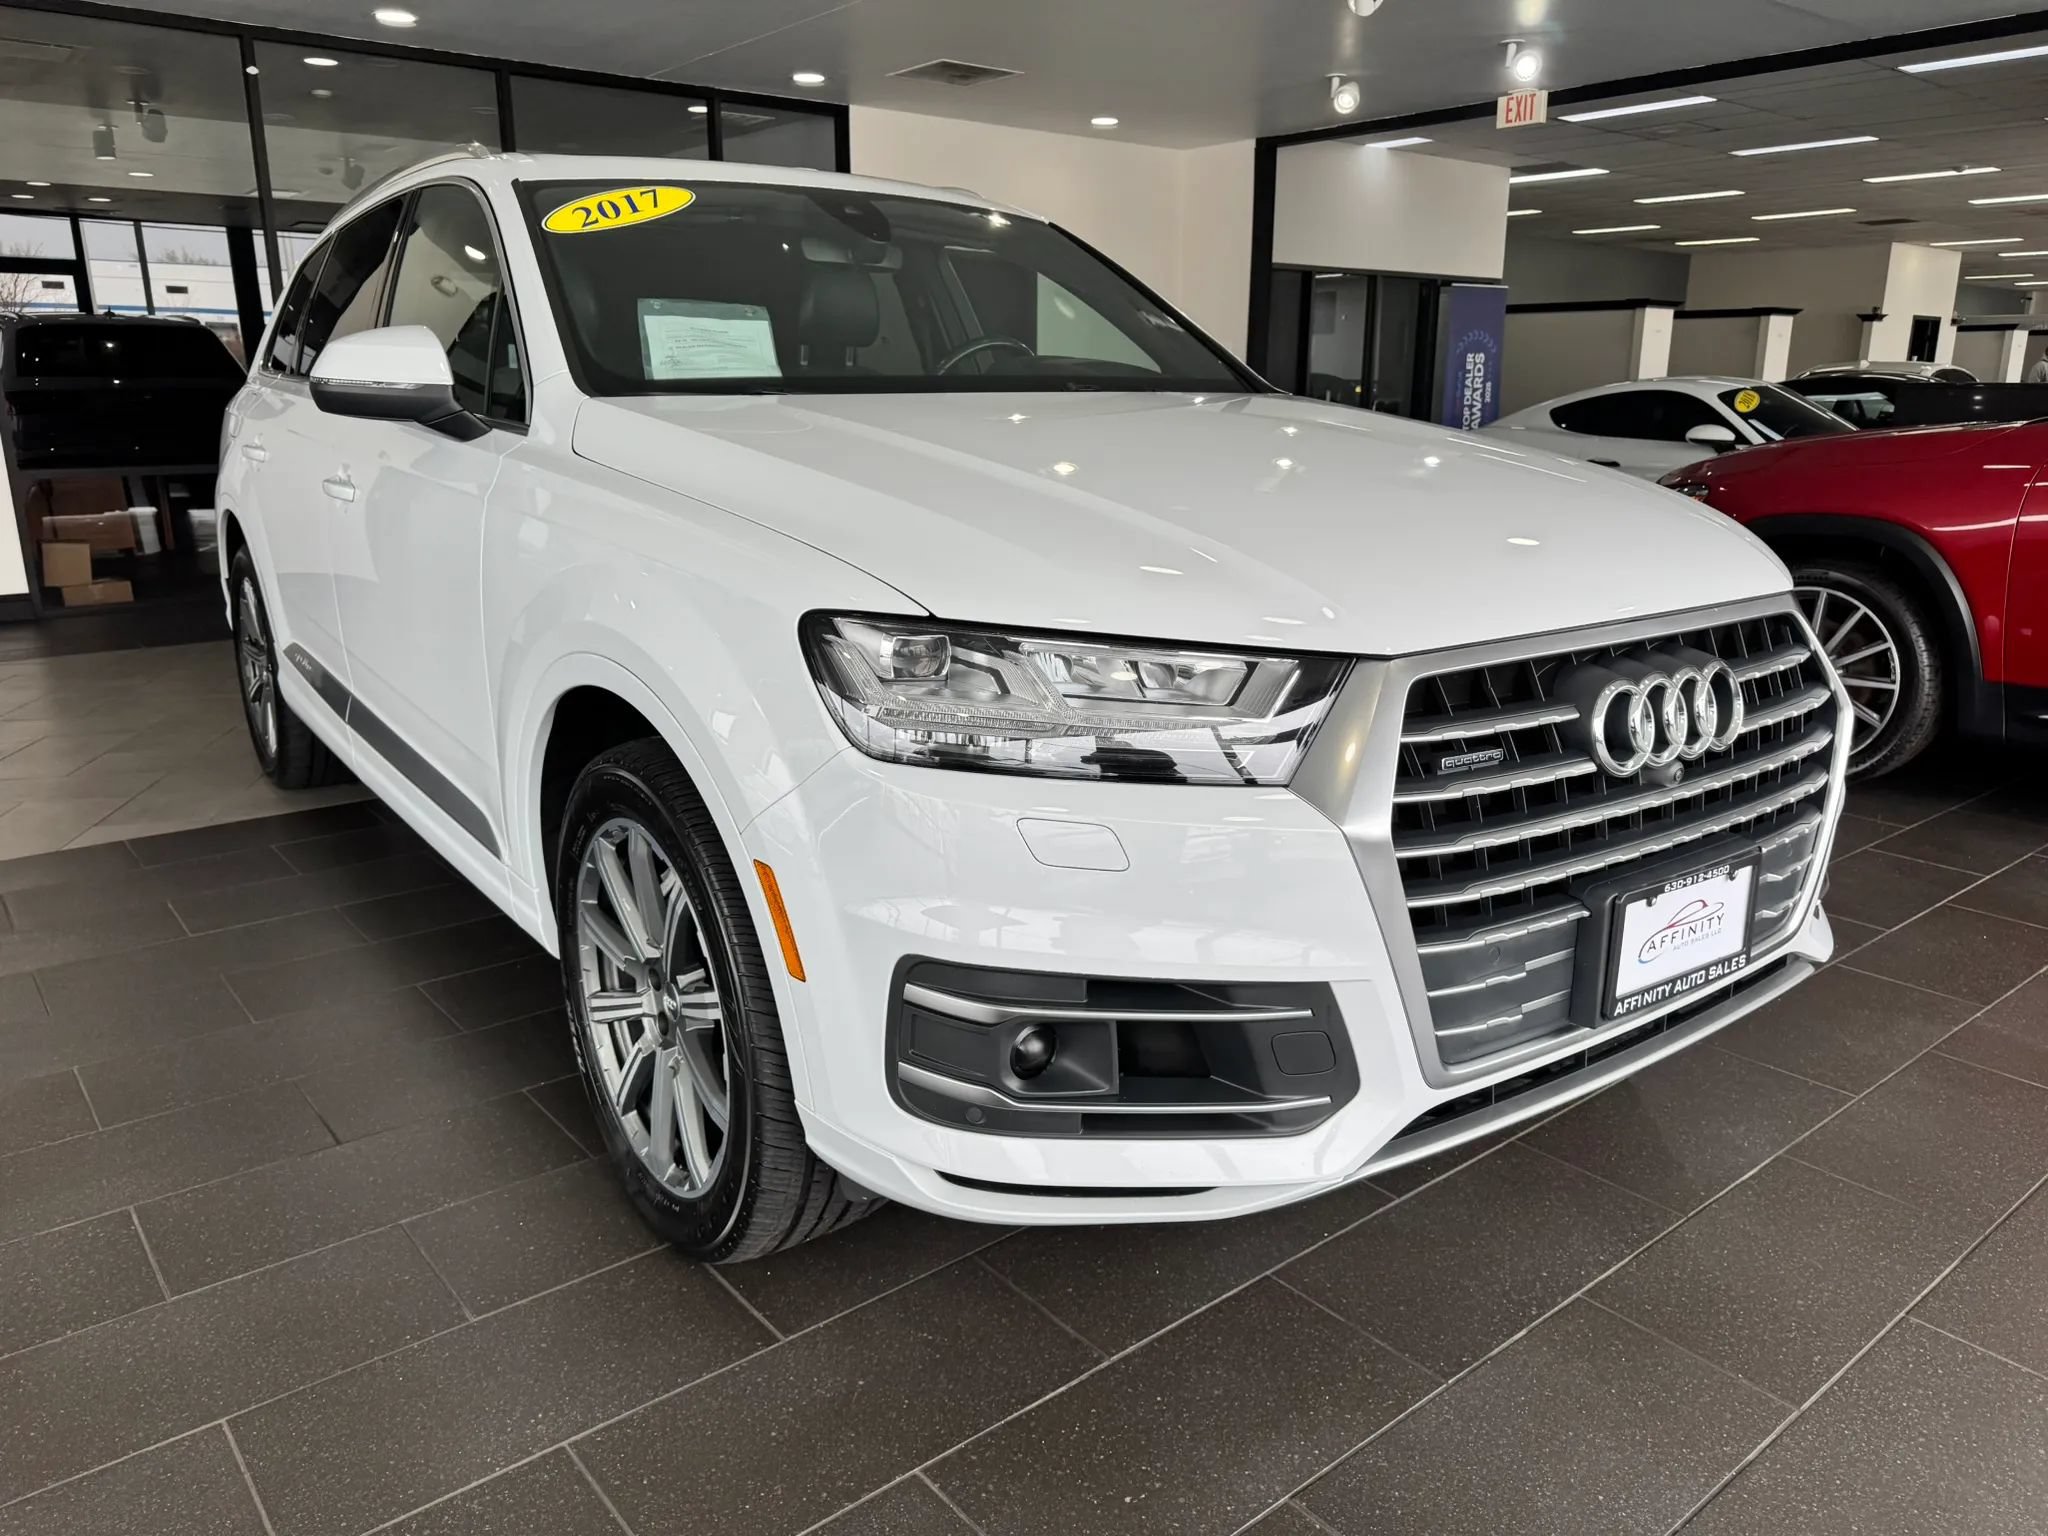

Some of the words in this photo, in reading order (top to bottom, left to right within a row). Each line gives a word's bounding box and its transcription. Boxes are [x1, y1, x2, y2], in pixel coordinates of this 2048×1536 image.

[1505, 93, 1537, 124] EXIT
[571, 188, 659, 229] 2017
[1463, 352, 1475, 406] DEALER
[1470, 351, 1486, 430] AWARDS
[1462, 406, 1472, 431] TOP
[1444, 751, 1502, 769] quattro
[1664, 864, 1730, 893] 630-912-4500
[1647, 912, 1725, 953] AFFINITY
[1613, 982, 1673, 1017] AFFINITY
[1673, 969, 1706, 994] AUTO
[1708, 954, 1747, 980] SALES
